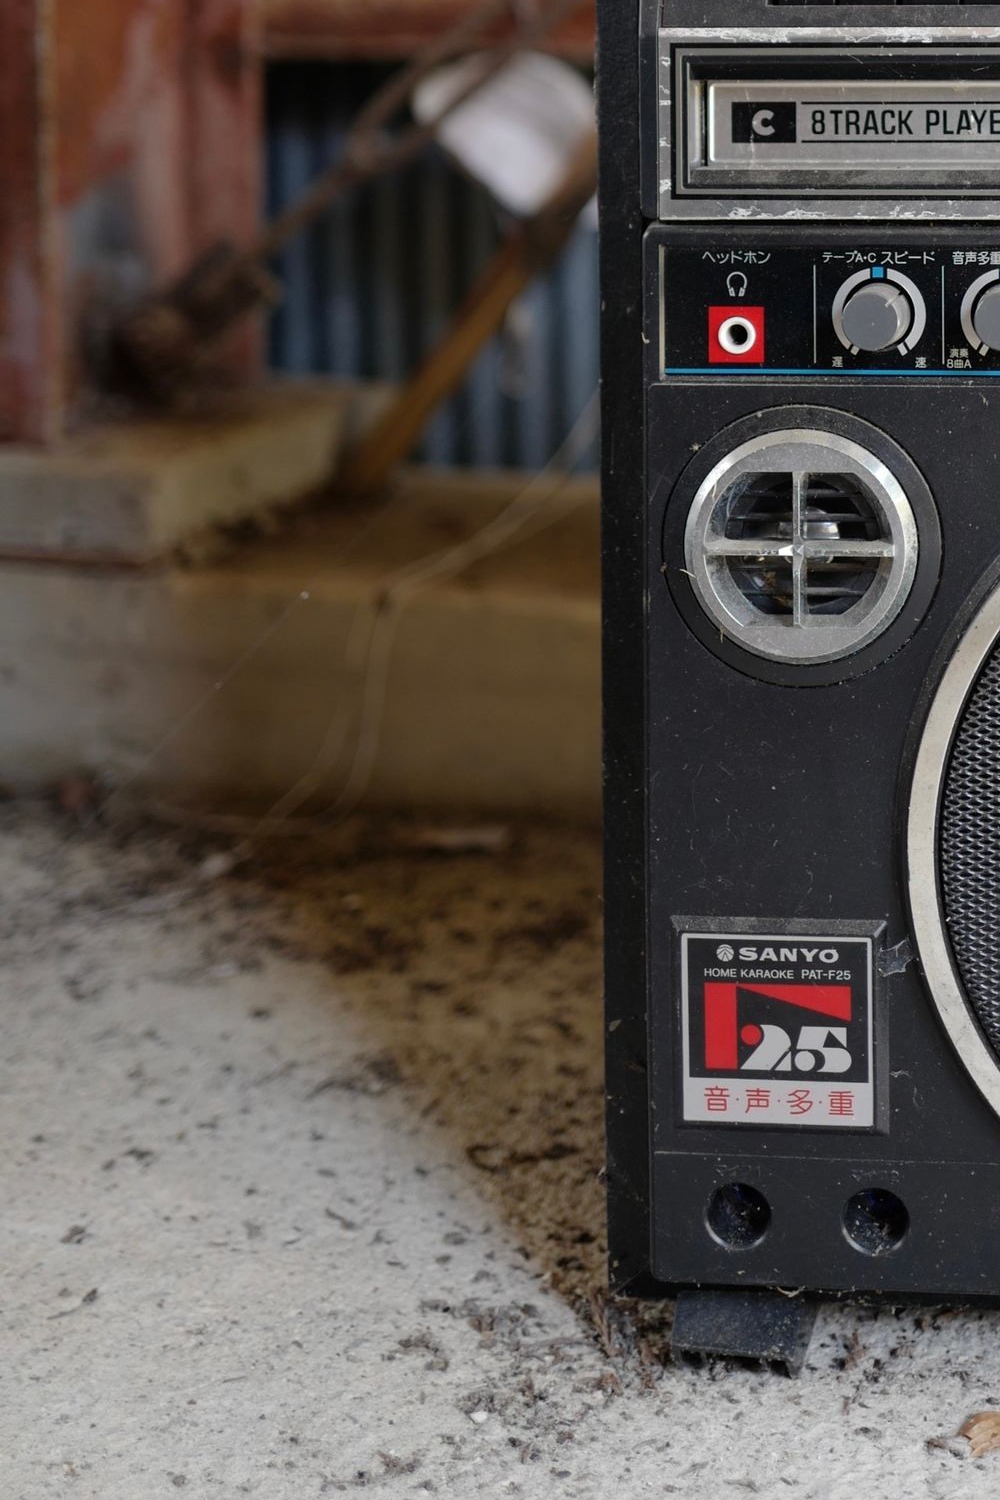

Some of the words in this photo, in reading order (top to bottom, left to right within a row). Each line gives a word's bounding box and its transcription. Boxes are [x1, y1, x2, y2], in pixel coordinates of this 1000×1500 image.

[752, 109, 775, 136] C
[702, 251, 771, 265] ヘッドホン
[881, 251, 935, 265] スピード
[946, 359, 972, 369] 8曲A
[738, 947, 839, 963] SANYO
[704, 968, 737, 978] HOME
[740, 969, 794, 979] KARAOKE
[801, 969, 851, 980] PAT-F25
